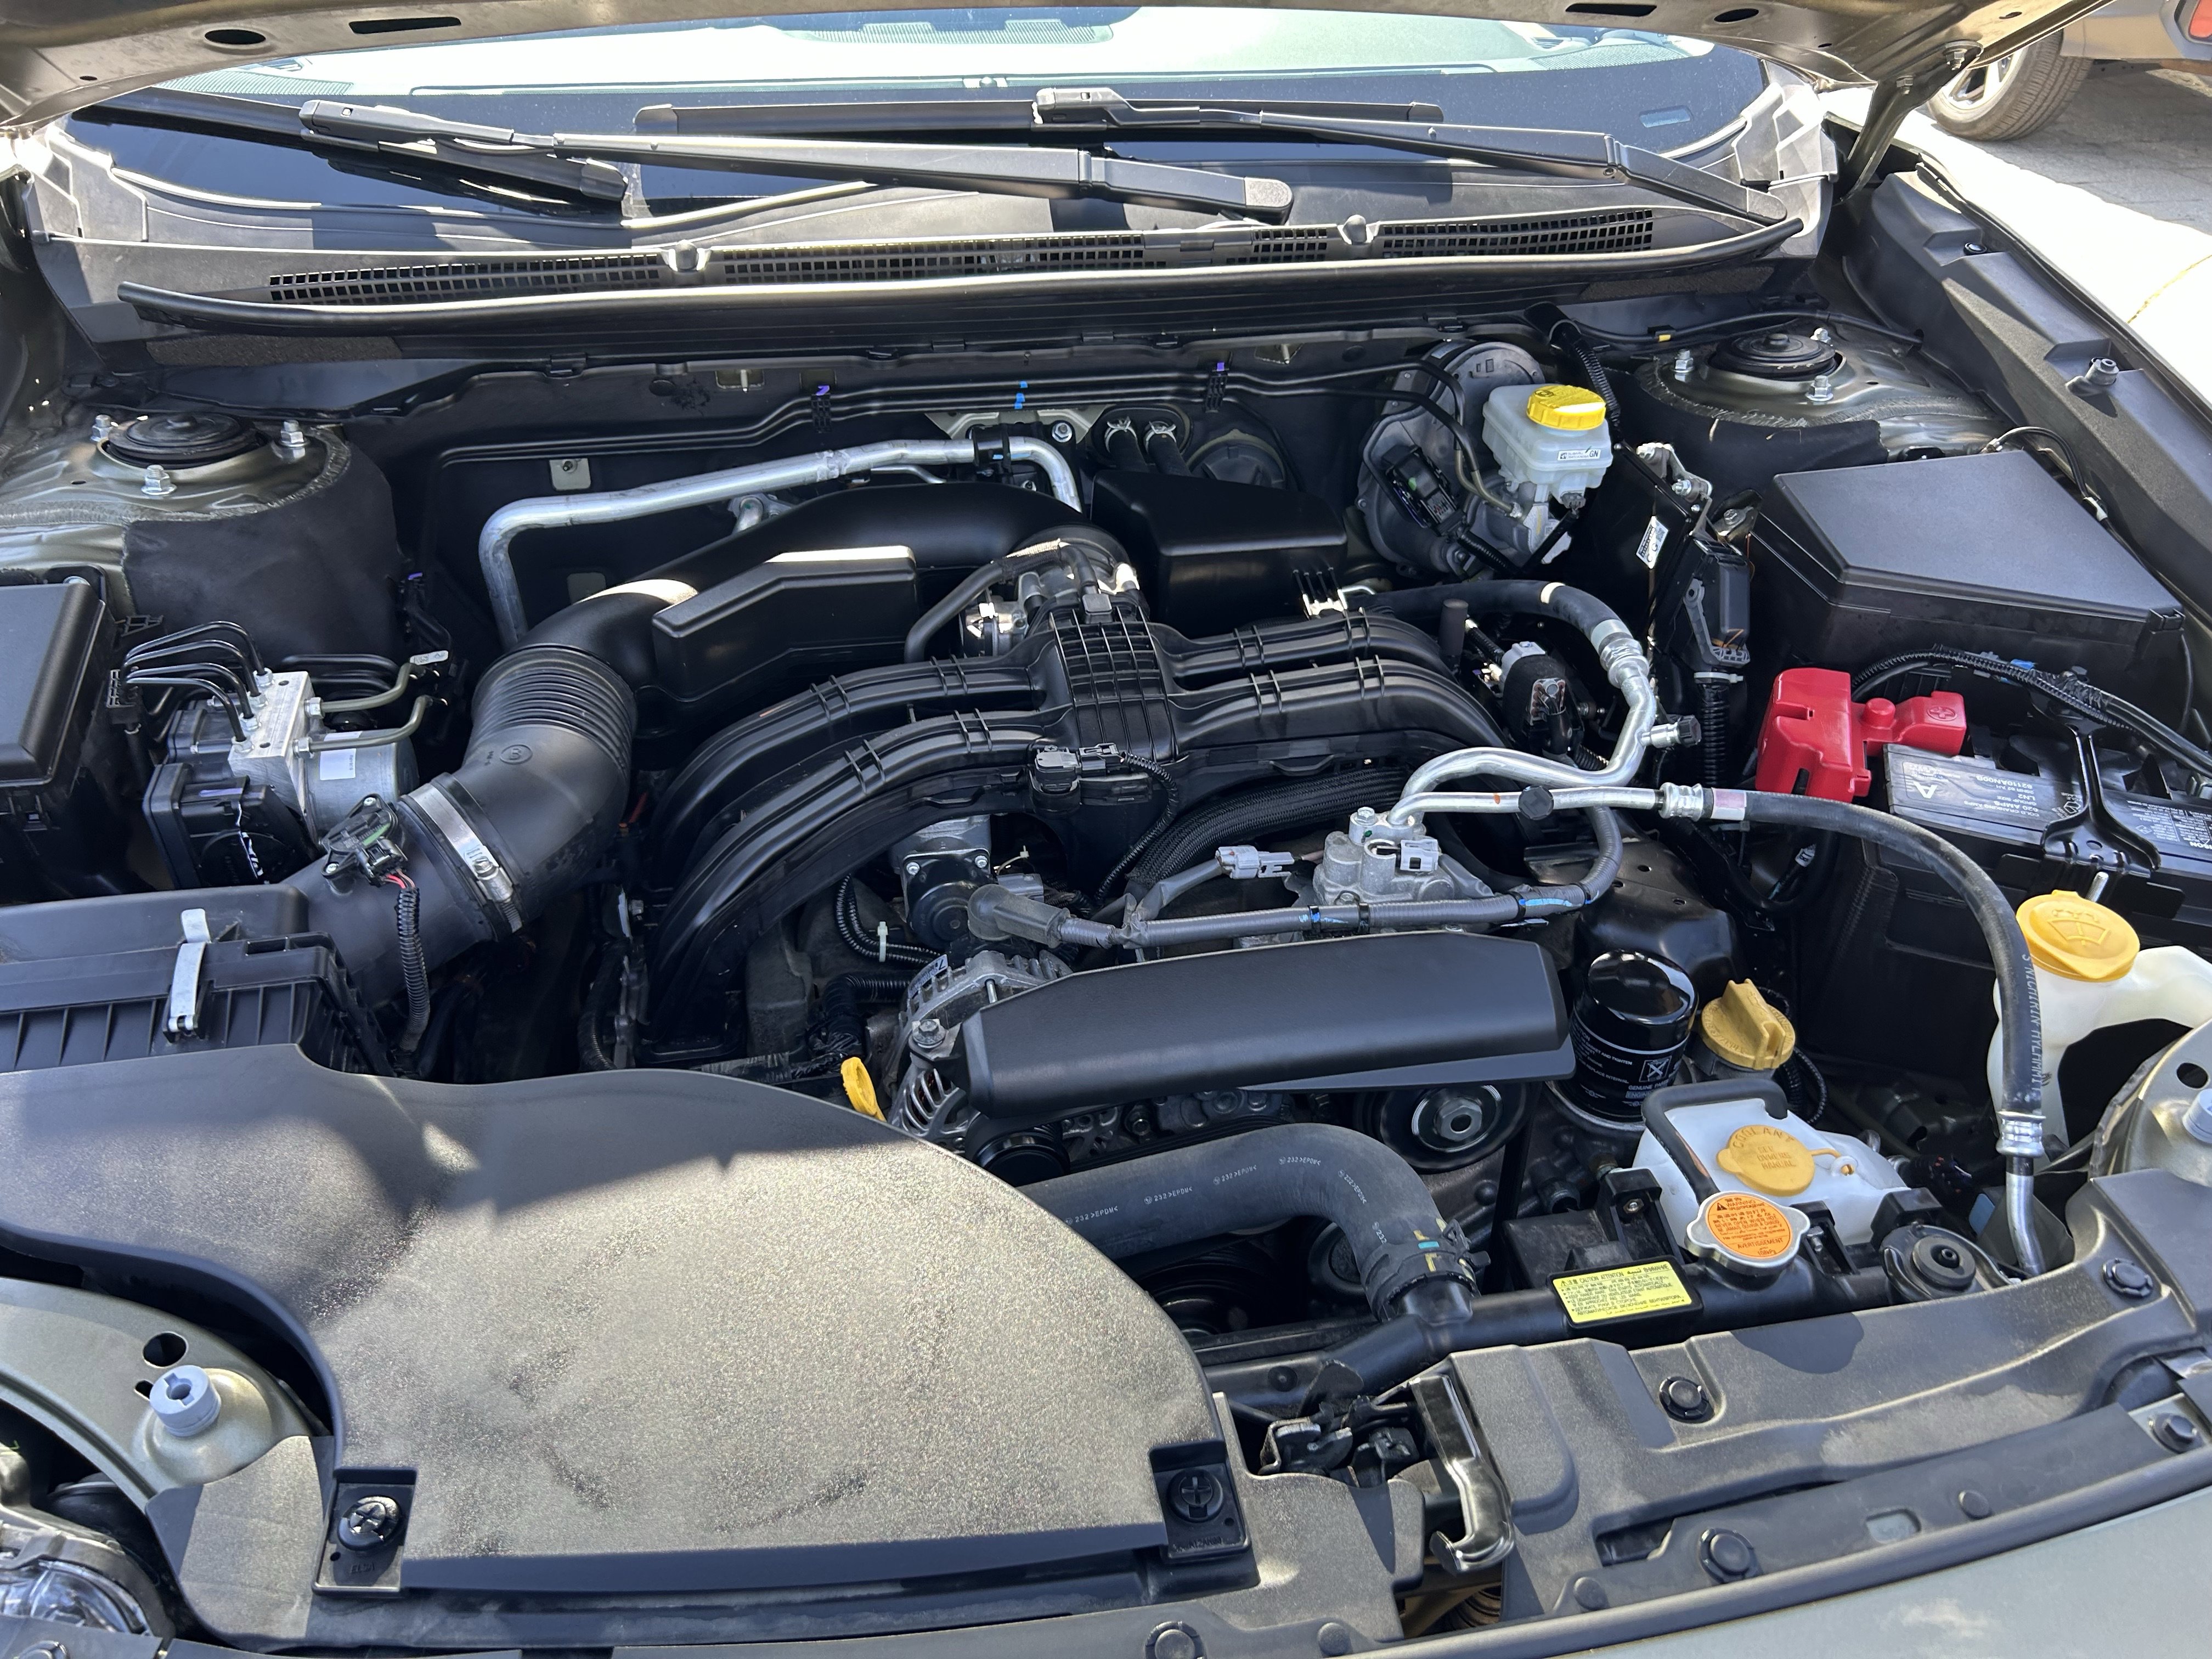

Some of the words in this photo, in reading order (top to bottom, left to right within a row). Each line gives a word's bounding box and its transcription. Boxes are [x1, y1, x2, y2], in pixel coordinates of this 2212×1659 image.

[1984, 804, 2019, 814] CRANKING
[1994, 800, 2020, 809] AMPS
[1733, 1127, 1795, 1149] COOLANT
[1761, 1160, 1797, 1170] MANUAL
[1737, 1237, 1783, 1249] AVERTISSEMENT
[1600, 1272, 1624, 1280] ATTENTION
